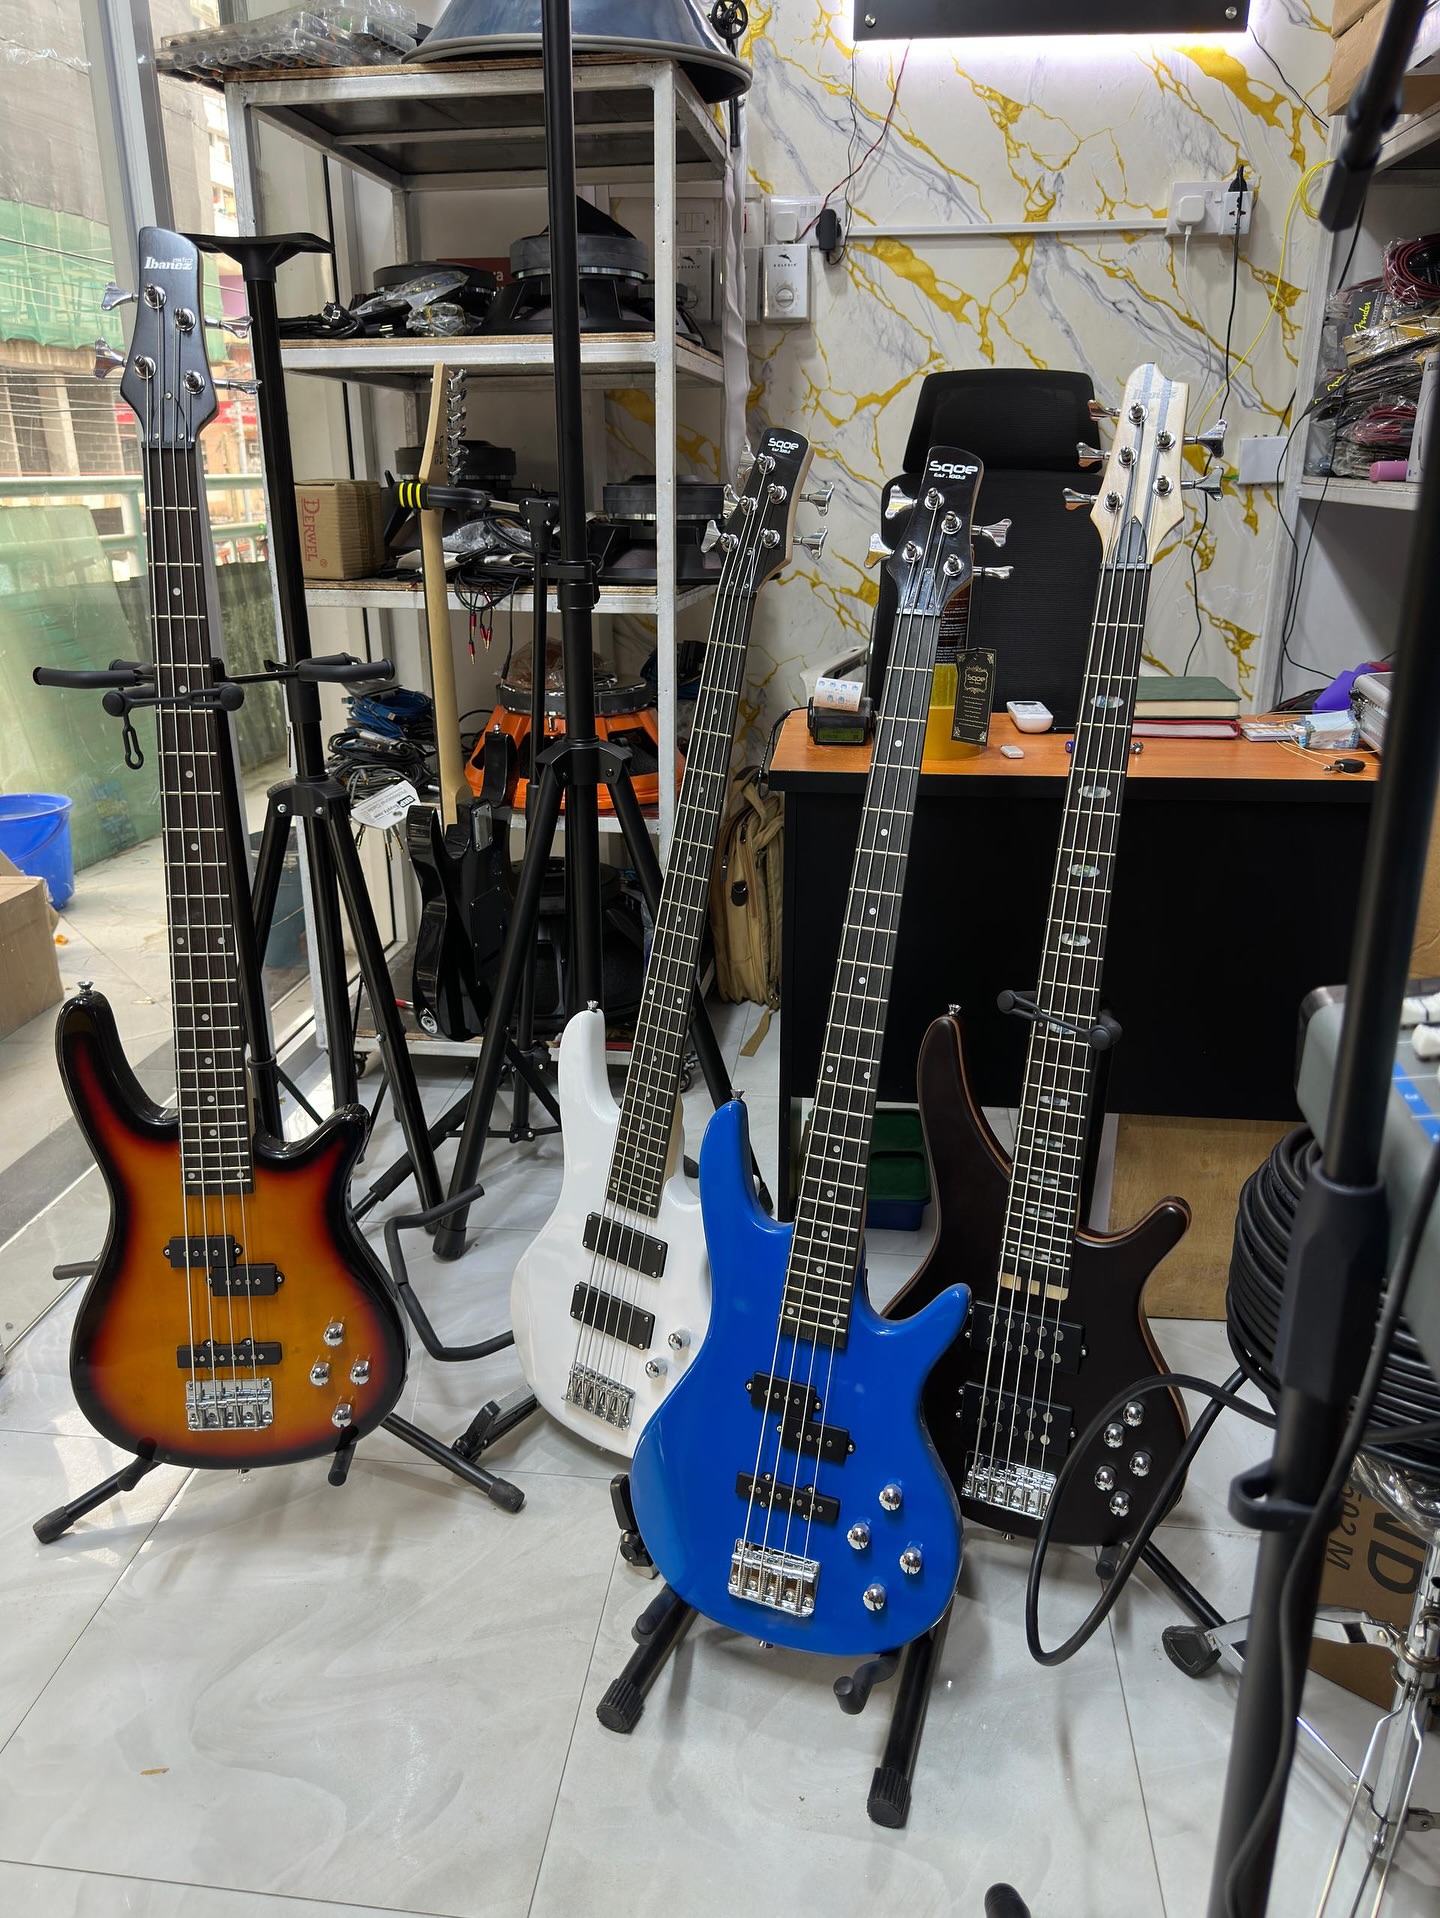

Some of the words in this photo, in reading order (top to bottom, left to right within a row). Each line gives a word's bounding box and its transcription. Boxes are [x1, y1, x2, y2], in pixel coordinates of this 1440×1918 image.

[143, 256, 193, 270] Ibanez
[1354, 302, 1371, 333] Fender
[928, 460, 978, 474] Sqoe
[303, 498, 320, 561] DERWEL
